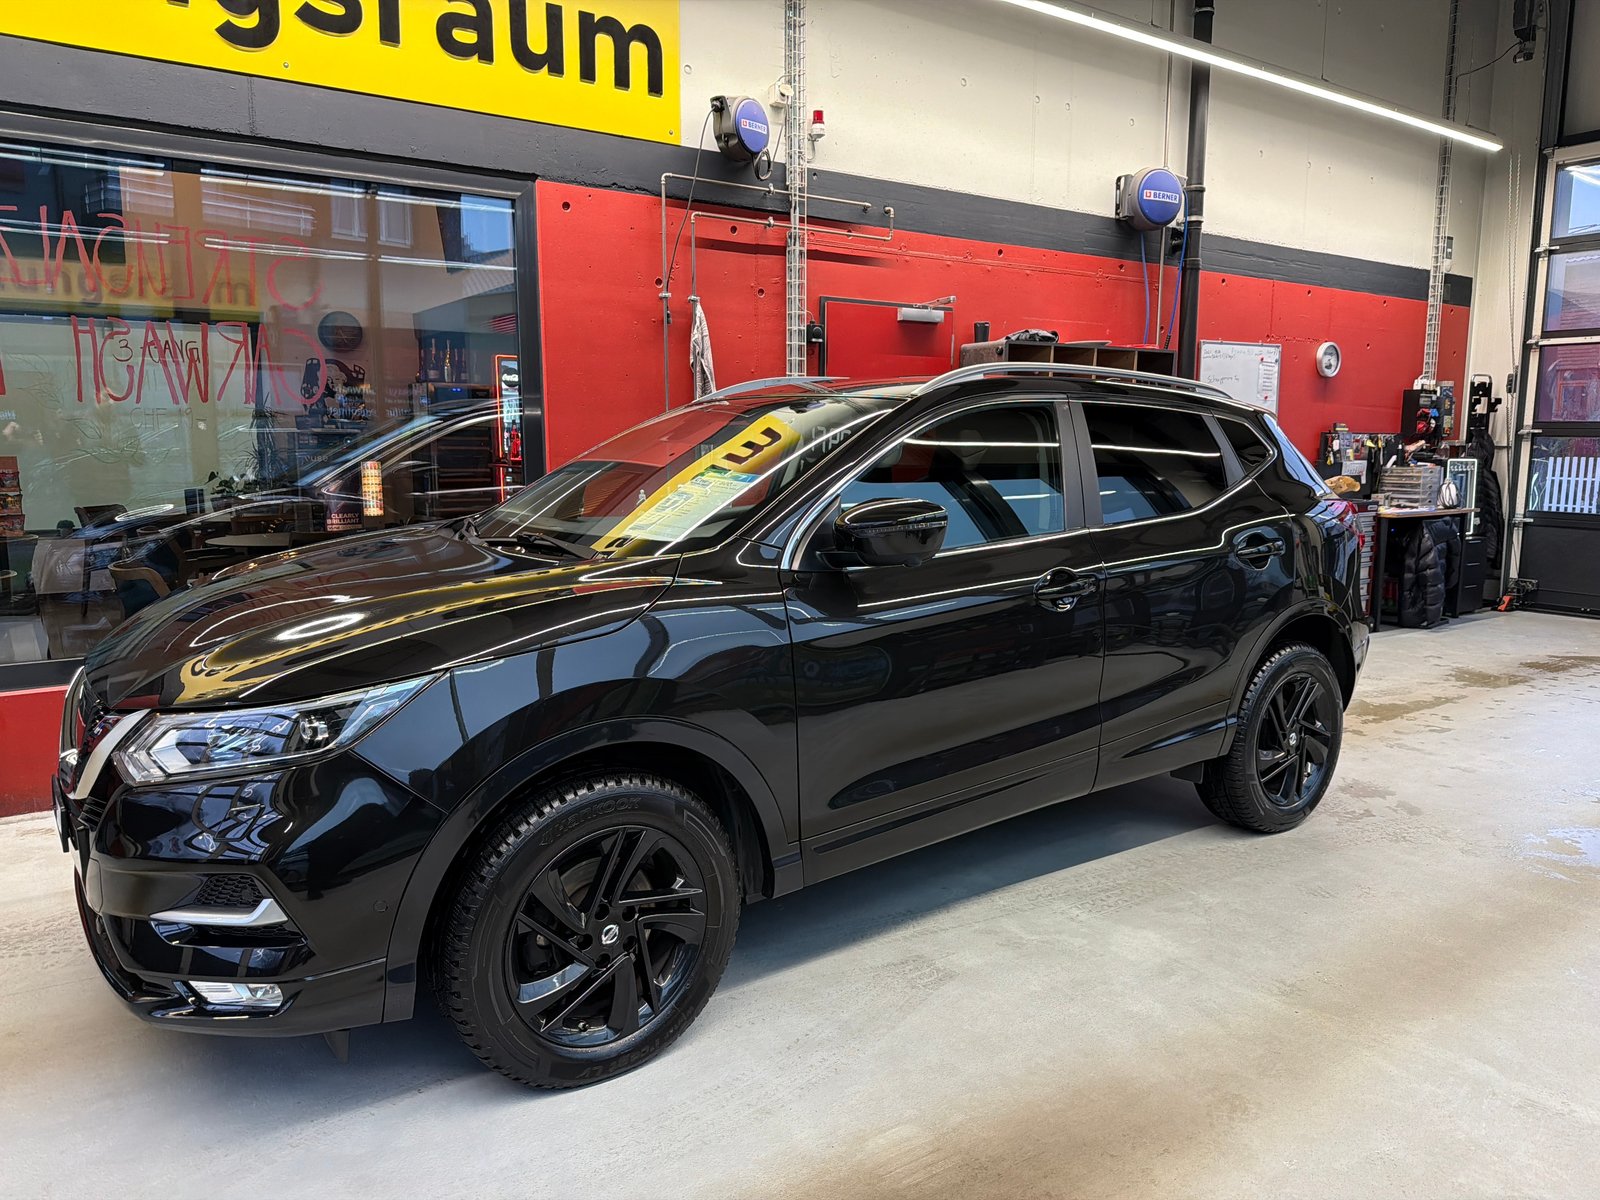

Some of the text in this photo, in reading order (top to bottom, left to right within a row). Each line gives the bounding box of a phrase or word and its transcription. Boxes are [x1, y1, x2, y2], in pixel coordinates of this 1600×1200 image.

[167, 0, 664, 98] gsraum
[749, 121, 767, 133] BERNER
[1153, 191, 1178, 202] BERNER
